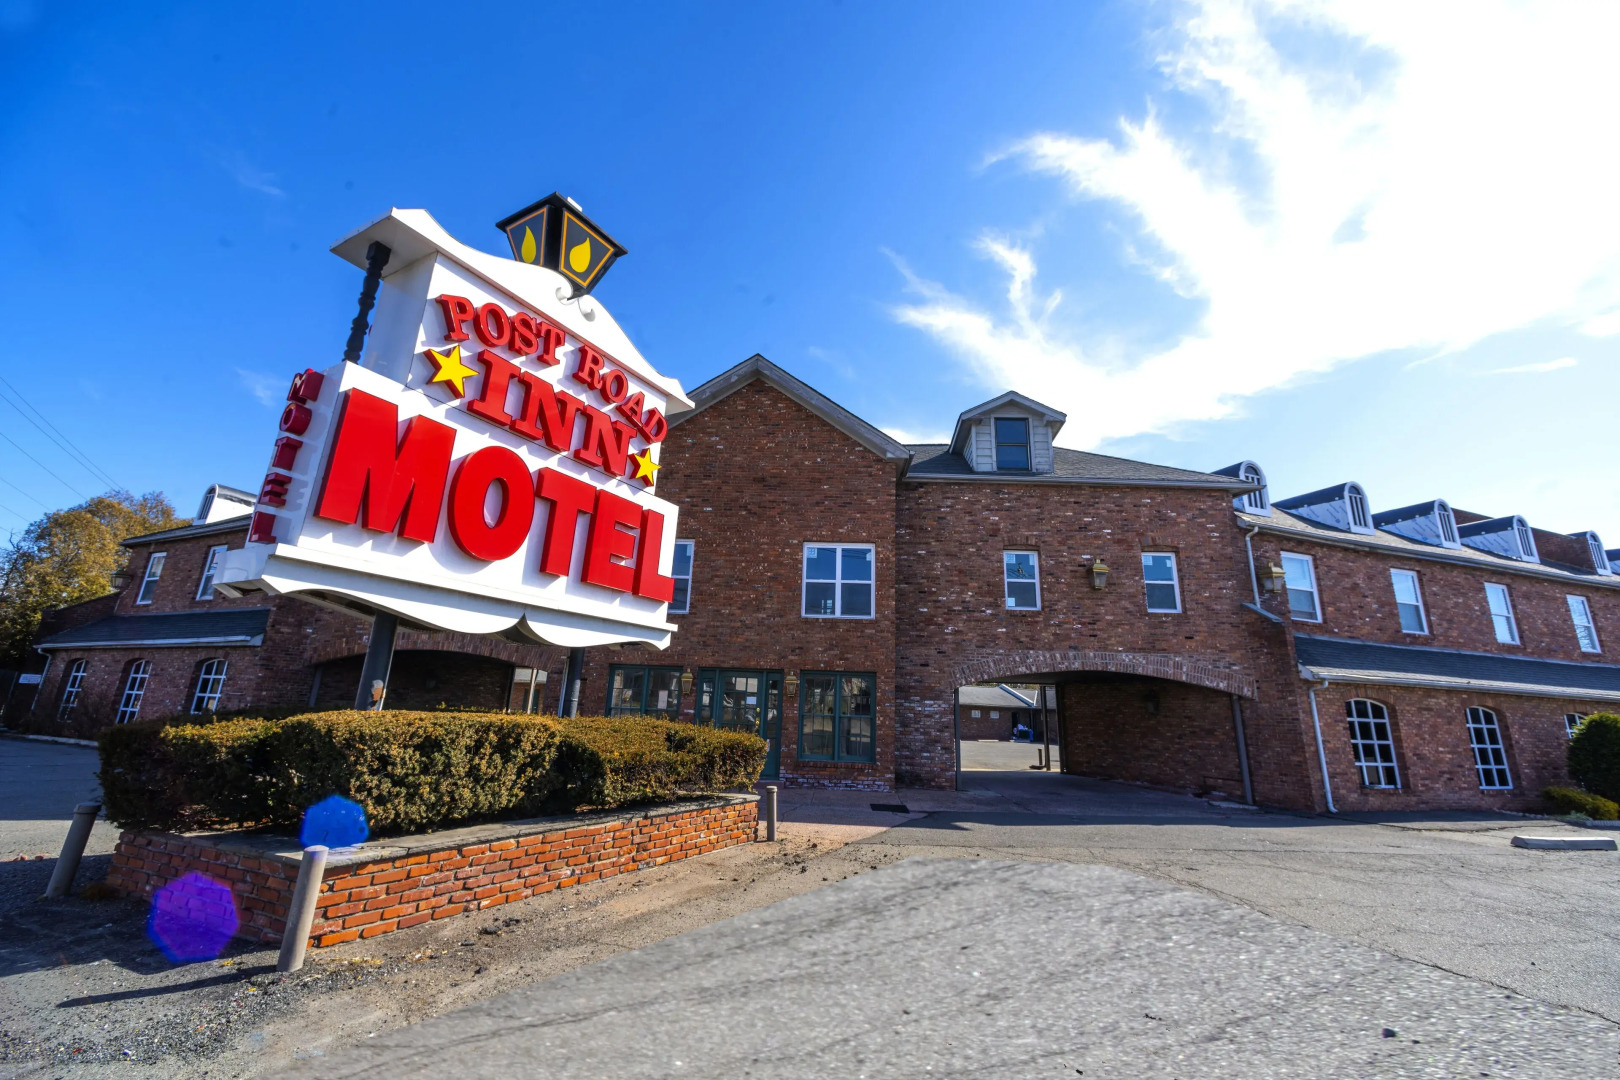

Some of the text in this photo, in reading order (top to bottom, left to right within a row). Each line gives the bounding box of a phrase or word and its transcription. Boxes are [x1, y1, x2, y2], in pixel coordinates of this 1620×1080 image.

[435, 294, 668, 444] POST ROAD
[467, 349, 637, 477] INN
[248, 368, 325, 543] MOTEL
[313, 387, 674, 603] MOTEL
